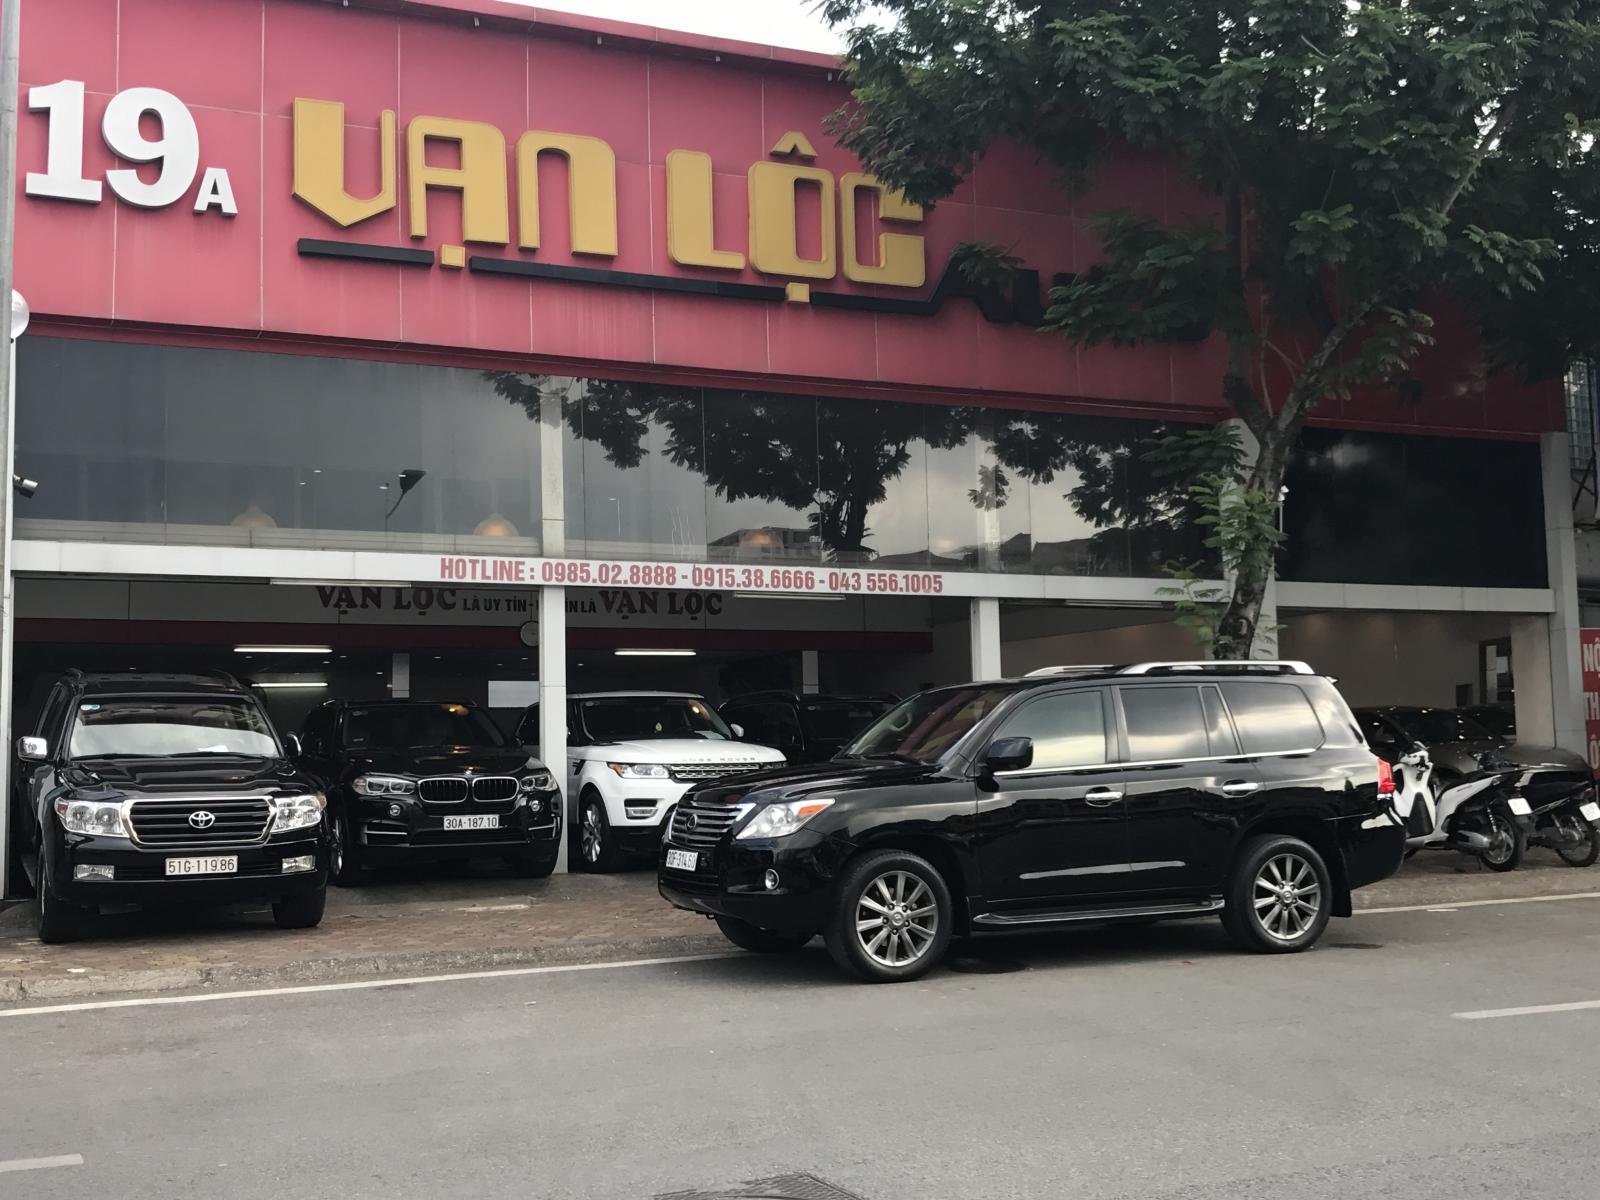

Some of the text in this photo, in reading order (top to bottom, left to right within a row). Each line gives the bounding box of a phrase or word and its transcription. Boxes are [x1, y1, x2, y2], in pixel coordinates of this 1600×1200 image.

[666, 131, 926, 303] LỘC
[542, 562, 677, 586] 0985.02.8888
[692, 567, 815, 590] 0915.38.6666
[484, 599, 501, 611] UY
[599, 589, 659, 620] VẠN
